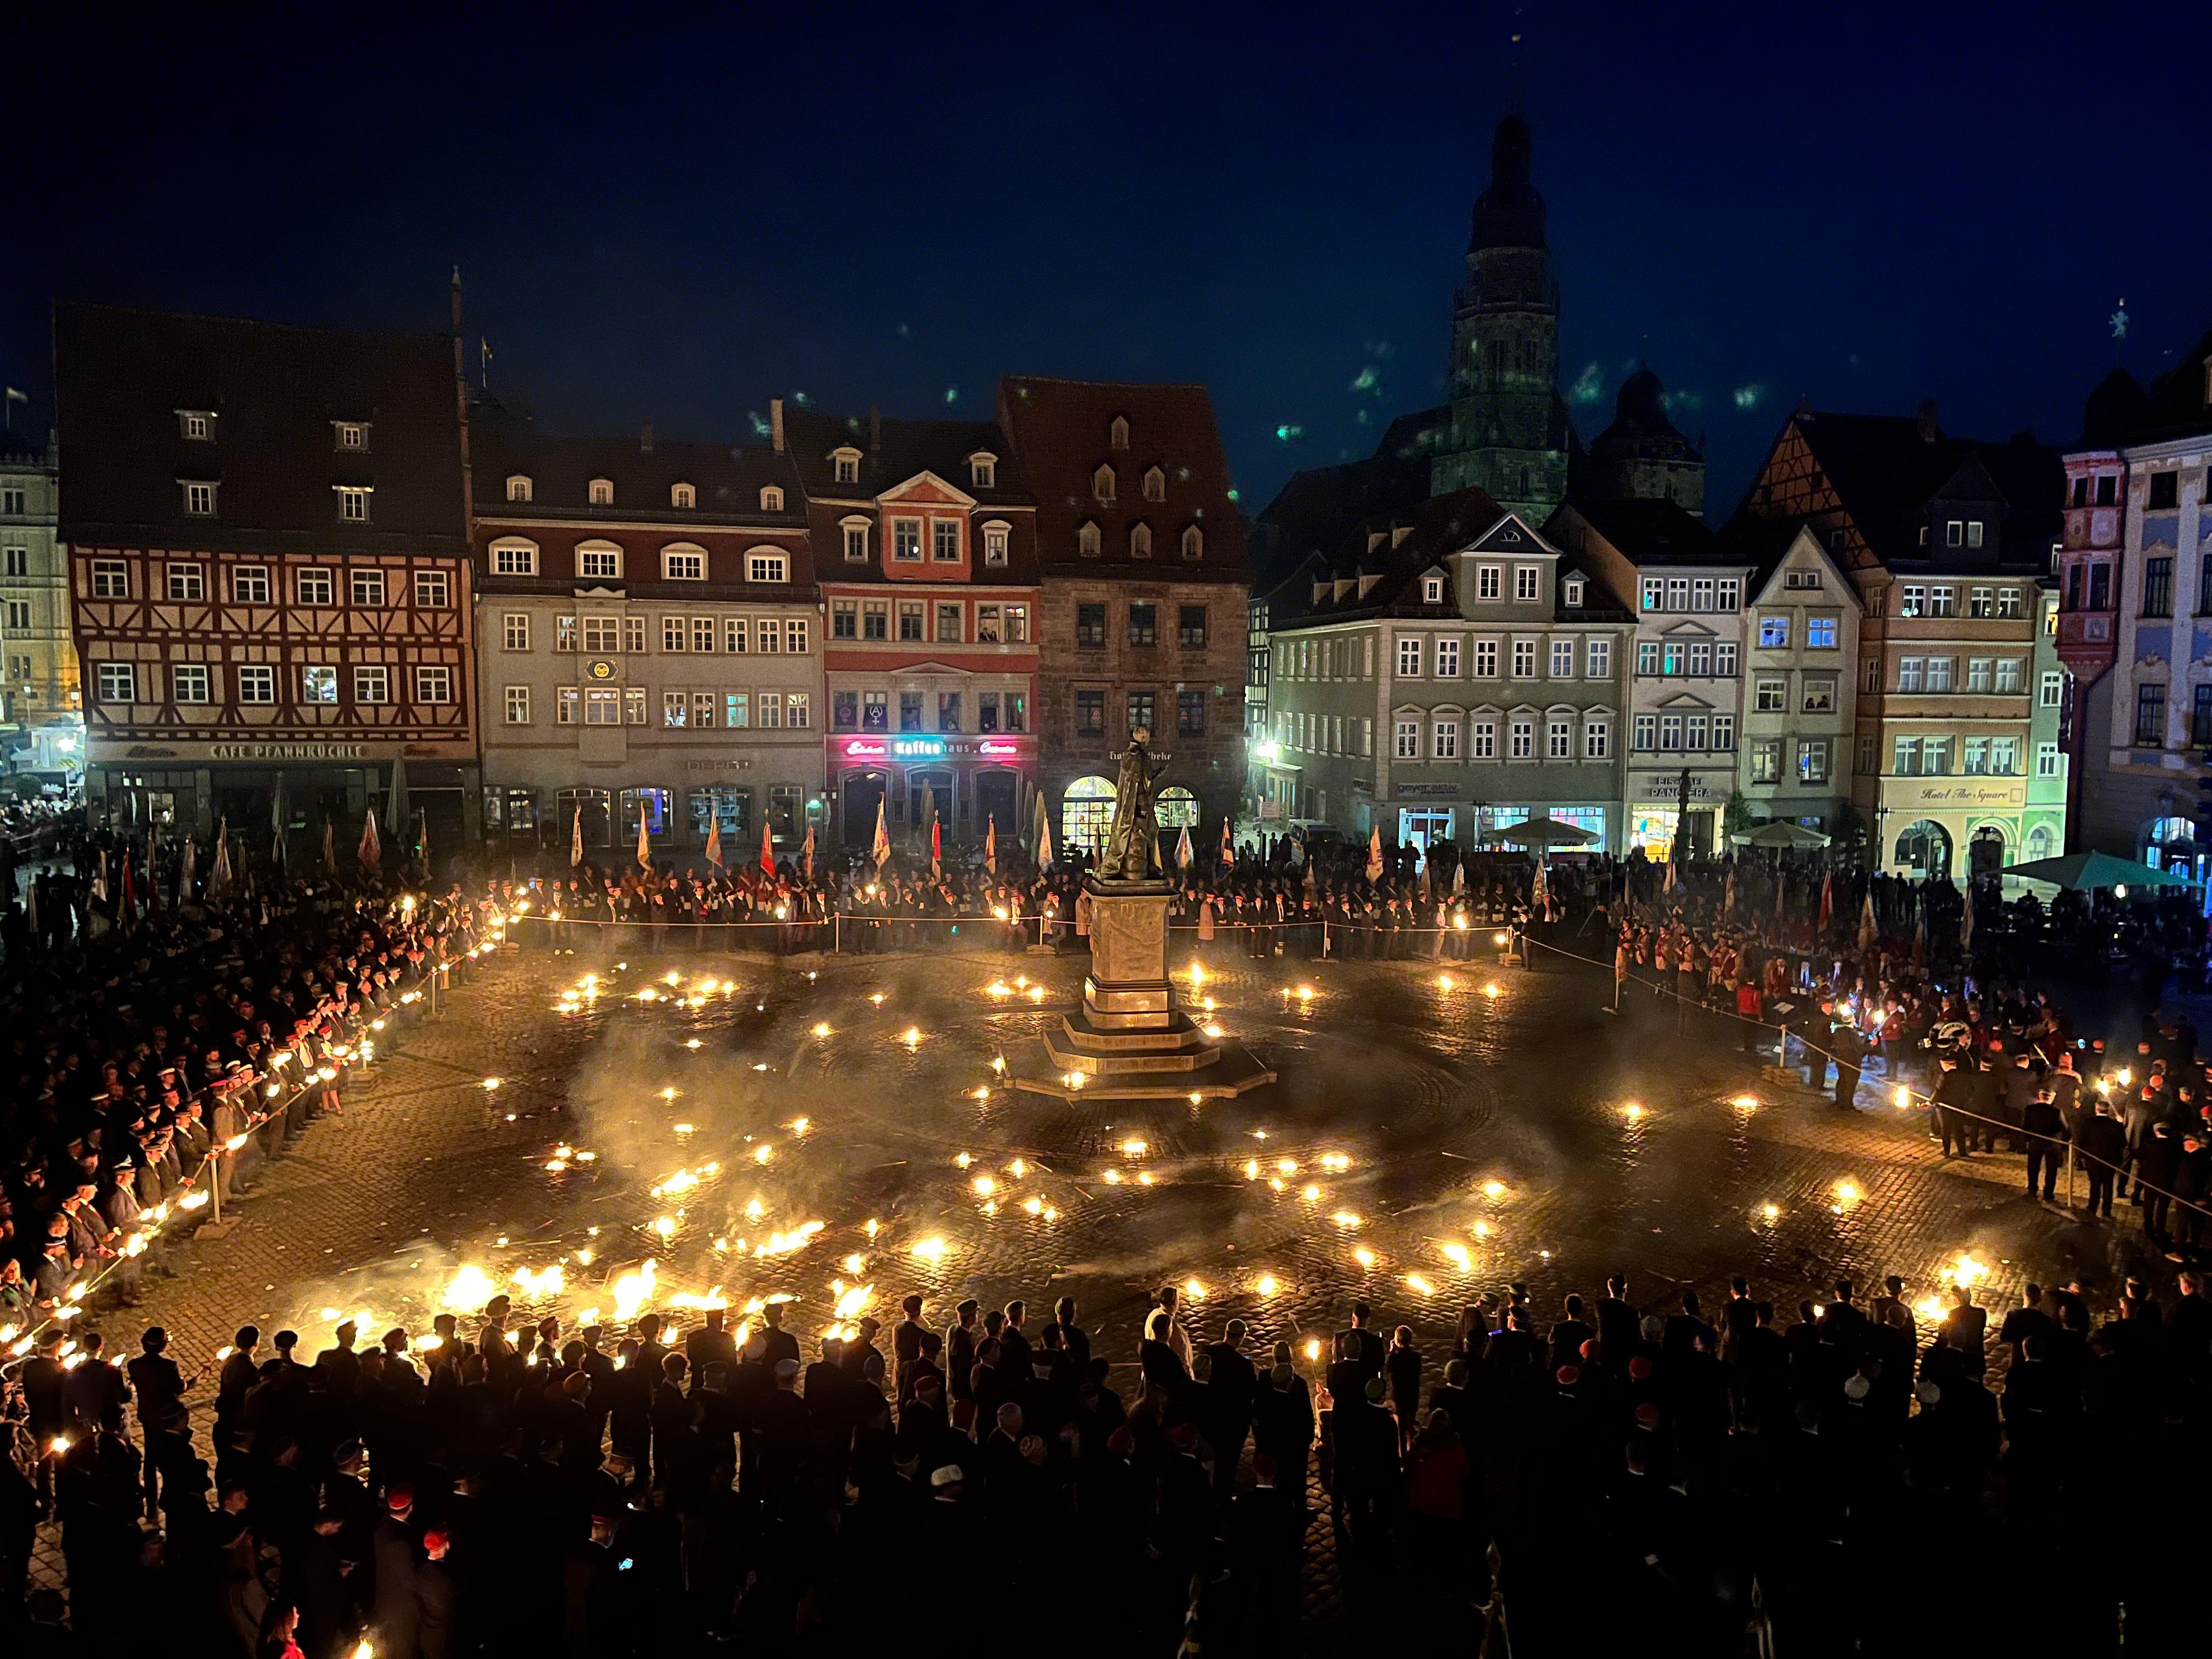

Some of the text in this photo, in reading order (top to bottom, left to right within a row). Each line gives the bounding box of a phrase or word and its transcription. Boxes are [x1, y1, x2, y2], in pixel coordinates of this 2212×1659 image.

[210, 743, 363, 758] CAFE PFANNKÜCHLE
[687, 760, 750, 770] DEPOT
[1397, 784, 1429, 793] geyer
[1651, 788, 1711, 798] PANCERA
[1921, 788, 2007, 803] Hotel The Square
